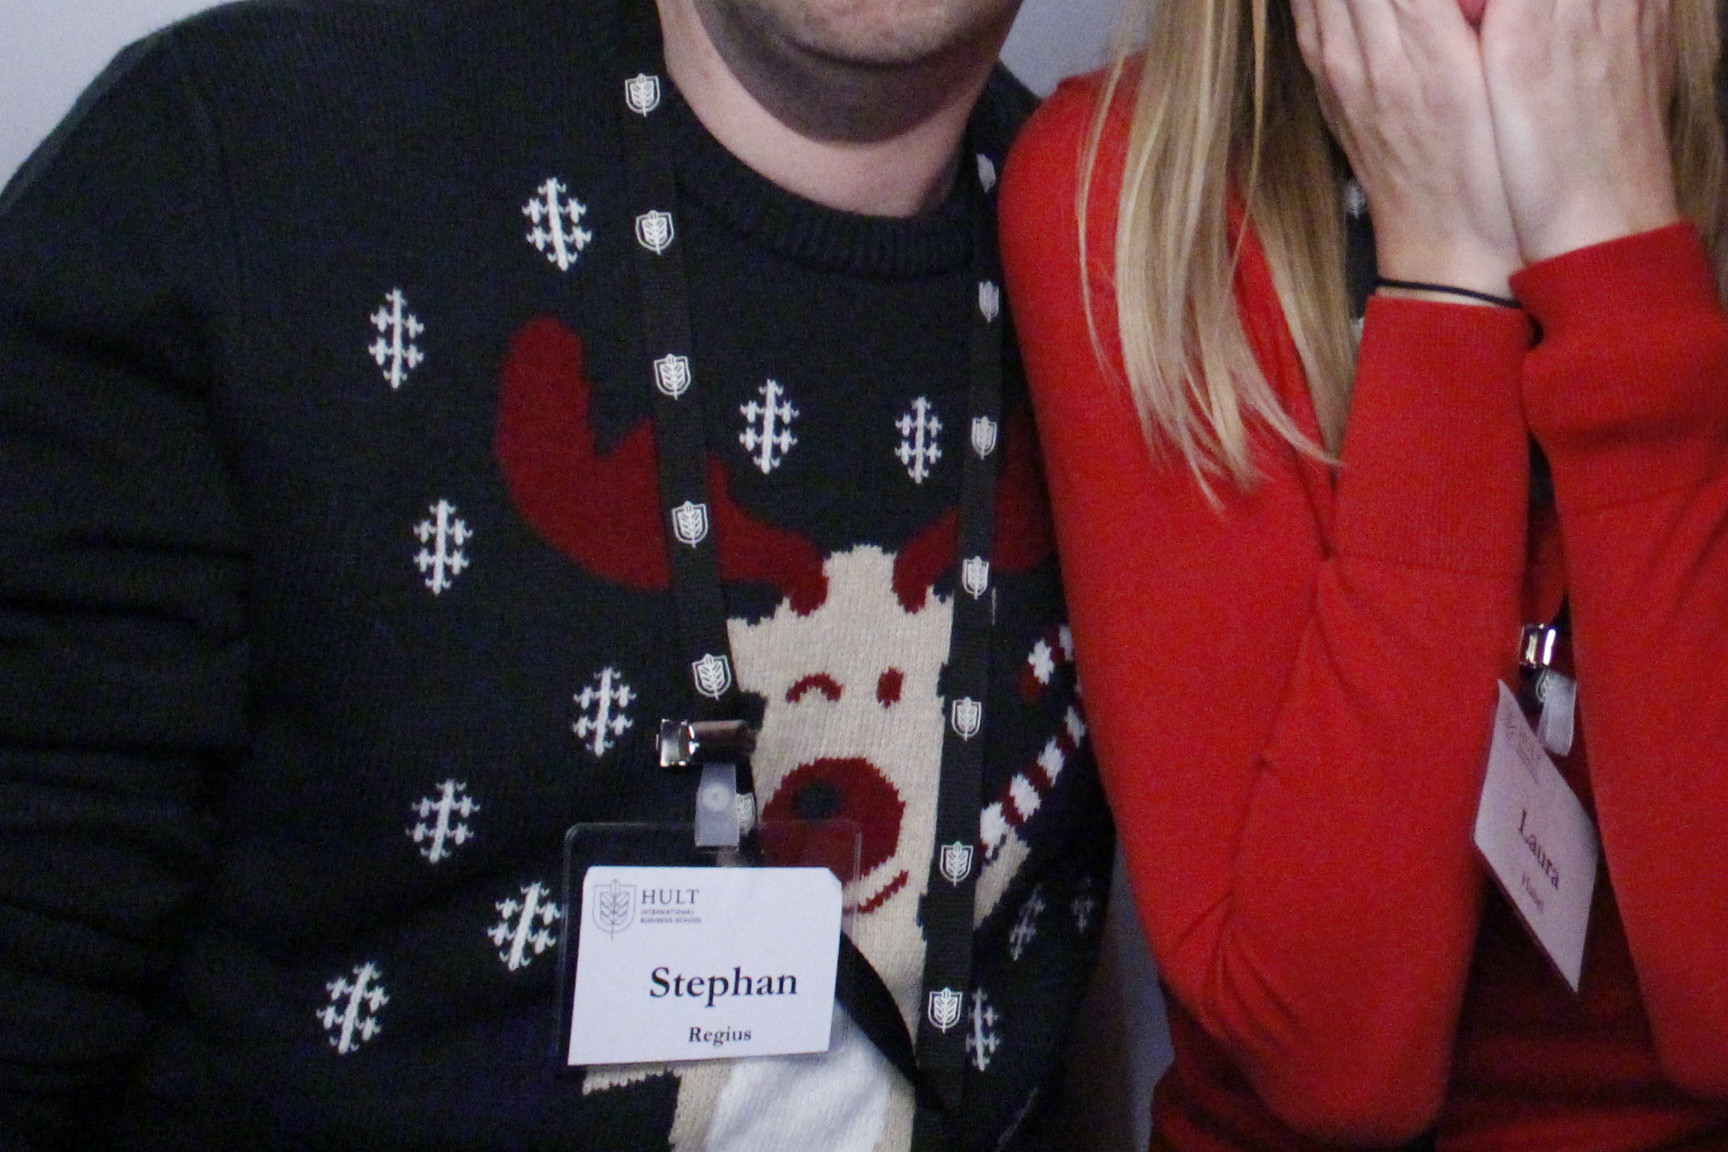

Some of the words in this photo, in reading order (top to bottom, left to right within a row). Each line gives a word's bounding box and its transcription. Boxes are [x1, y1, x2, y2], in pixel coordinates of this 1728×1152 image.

[1518, 809, 1559, 890] Laura
[641, 889, 700, 904] HULT
[649, 966, 798, 1008] Stephan
[688, 1026, 752, 1046] Regius
